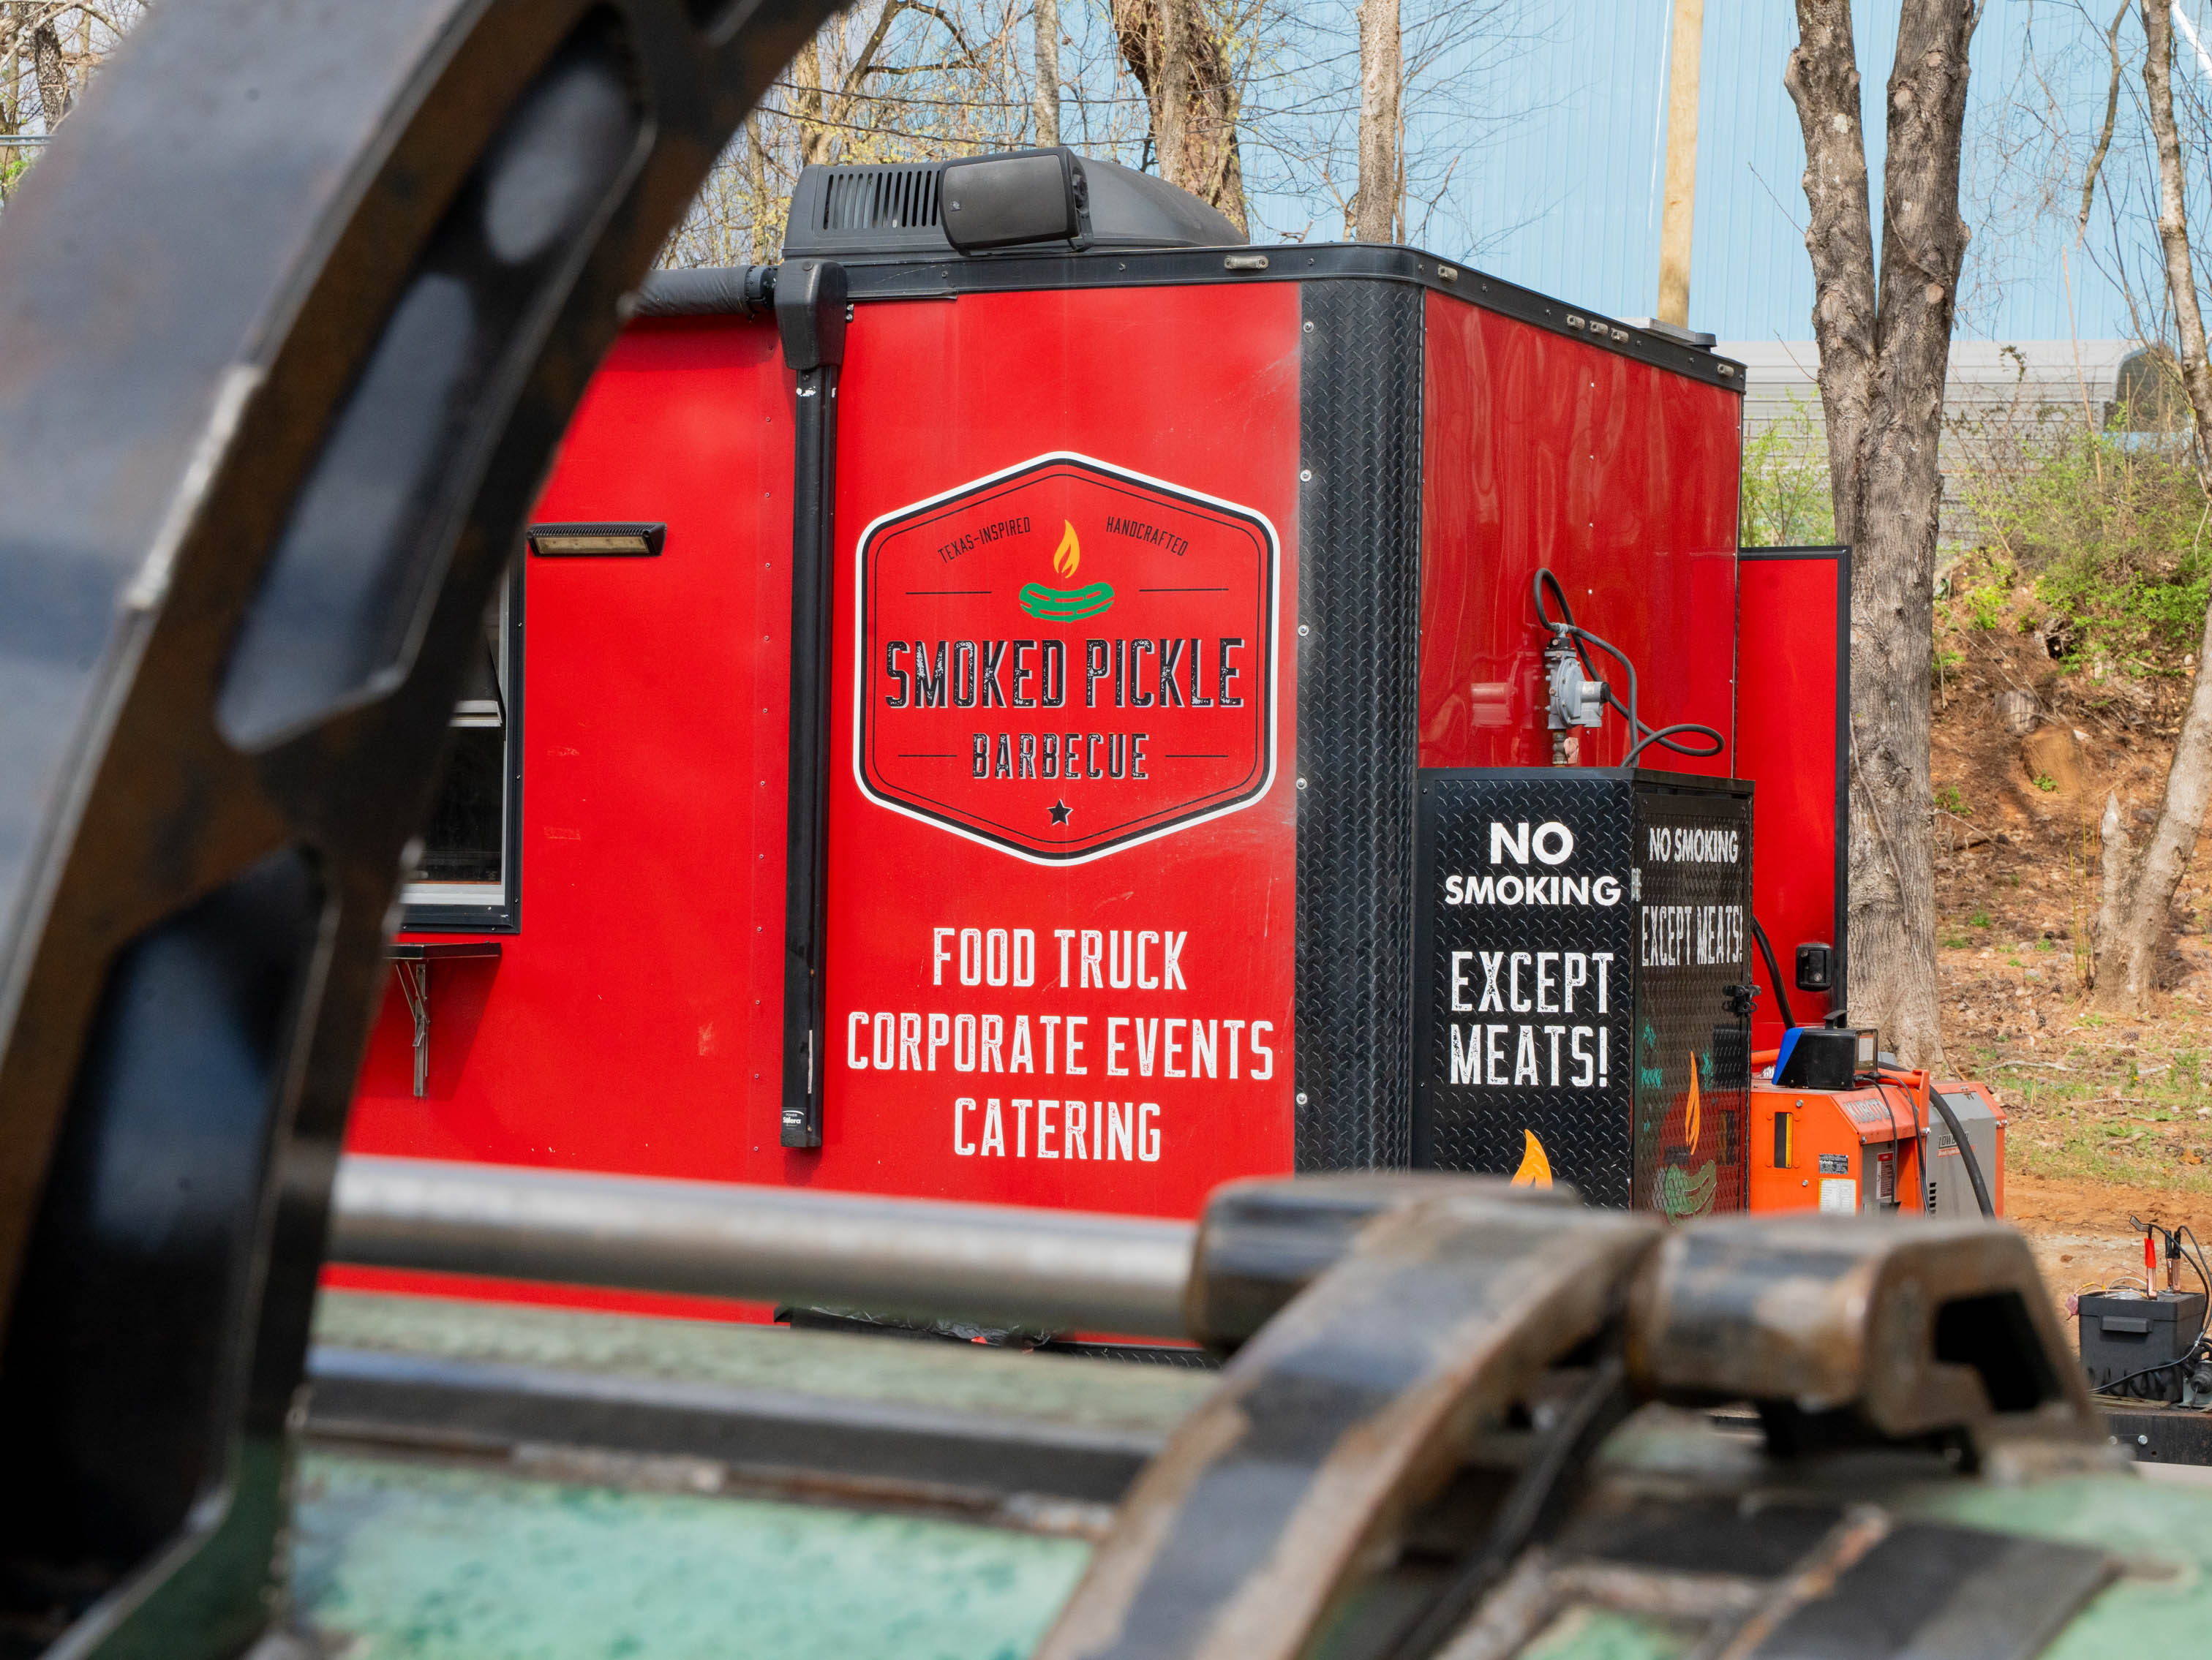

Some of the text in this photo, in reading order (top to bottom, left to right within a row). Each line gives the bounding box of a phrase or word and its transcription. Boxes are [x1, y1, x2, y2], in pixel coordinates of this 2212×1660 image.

[938, 516, 1031, 564] TEXAS-INSPIRED
[1105, 516, 1189, 557] HANDCRAFTED
[885, 638, 1245, 709] SMOKED PICKLE
[972, 733, 1149, 780] BARBECUE
[1490, 821, 1574, 865] NO
[1649, 827, 1739, 864] NO SMOKING
[1445, 875, 1622, 906] SMOKING
[933, 927, 1188, 990] FOOD TRUCK
[1641, 905, 1742, 966] EXCEPT MEATS!
[1451, 951, 1615, 1014] EXCEPT
[848, 1011, 1274, 1080] CORPORATE EVENTS
[1450, 1024, 1608, 1087] MEATS!
[955, 1098, 1161, 1162] CATERING
